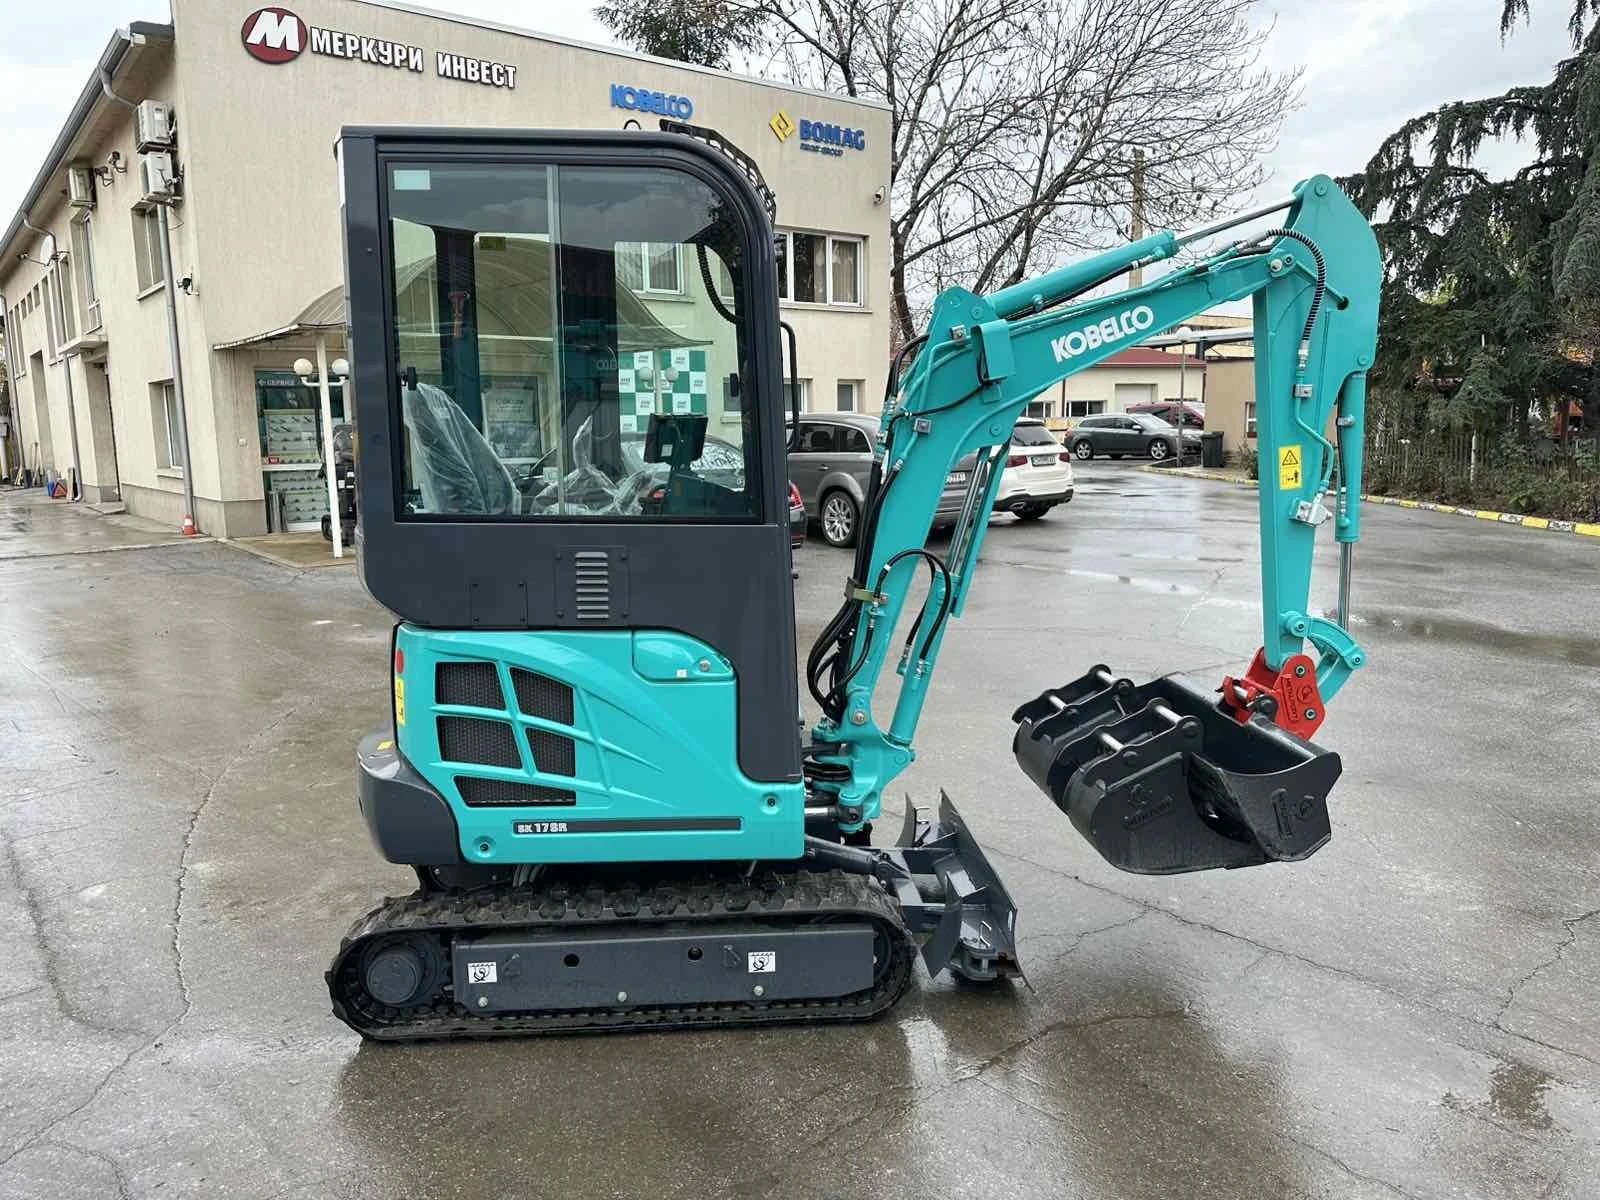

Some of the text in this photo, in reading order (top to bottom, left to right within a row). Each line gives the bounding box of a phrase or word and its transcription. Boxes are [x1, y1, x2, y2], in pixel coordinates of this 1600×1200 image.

[310, 26, 518, 89] МЕРКУРИ ИНВЕСТ
[611, 83, 694, 120] KOBELCO
[799, 119, 866, 151] BOMAG
[1050, 305, 1154, 363] KOBELCO
